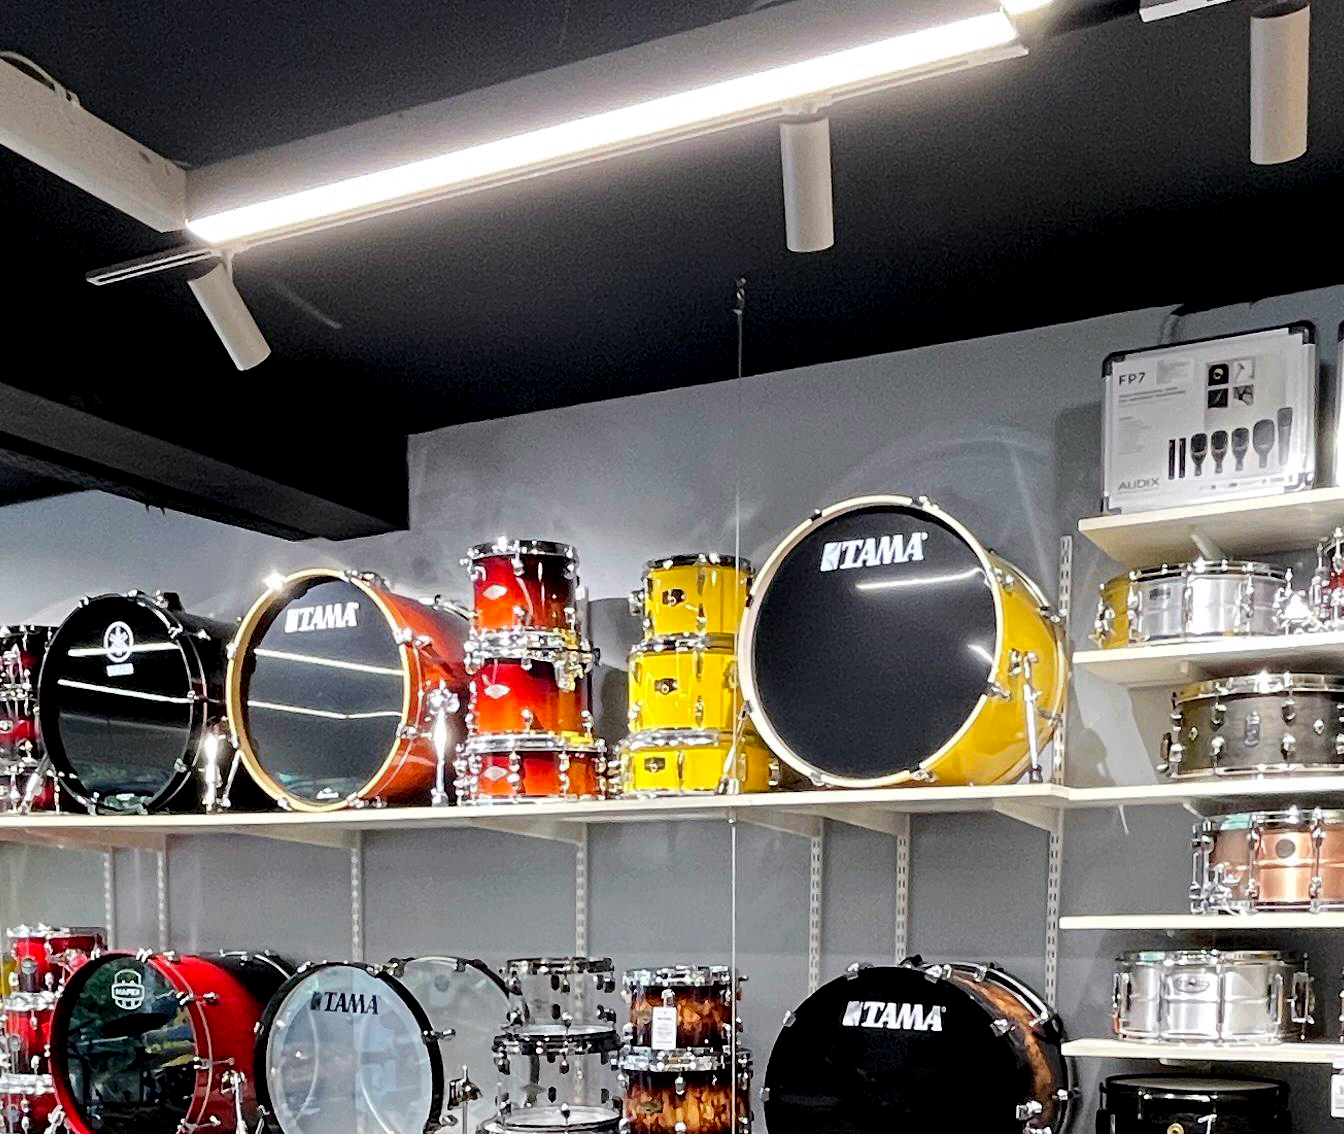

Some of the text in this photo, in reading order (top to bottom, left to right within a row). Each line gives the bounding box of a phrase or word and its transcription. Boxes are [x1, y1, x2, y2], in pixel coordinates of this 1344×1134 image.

[1119, 372, 1146, 386] FP7
[1118, 477, 1160, 491] AUDIX
[839, 532, 925, 570] TAMA
[297, 602, 358, 632] TAMA
[324, 991, 379, 1015] TAMA
[861, 1001, 943, 1032] TAMA
